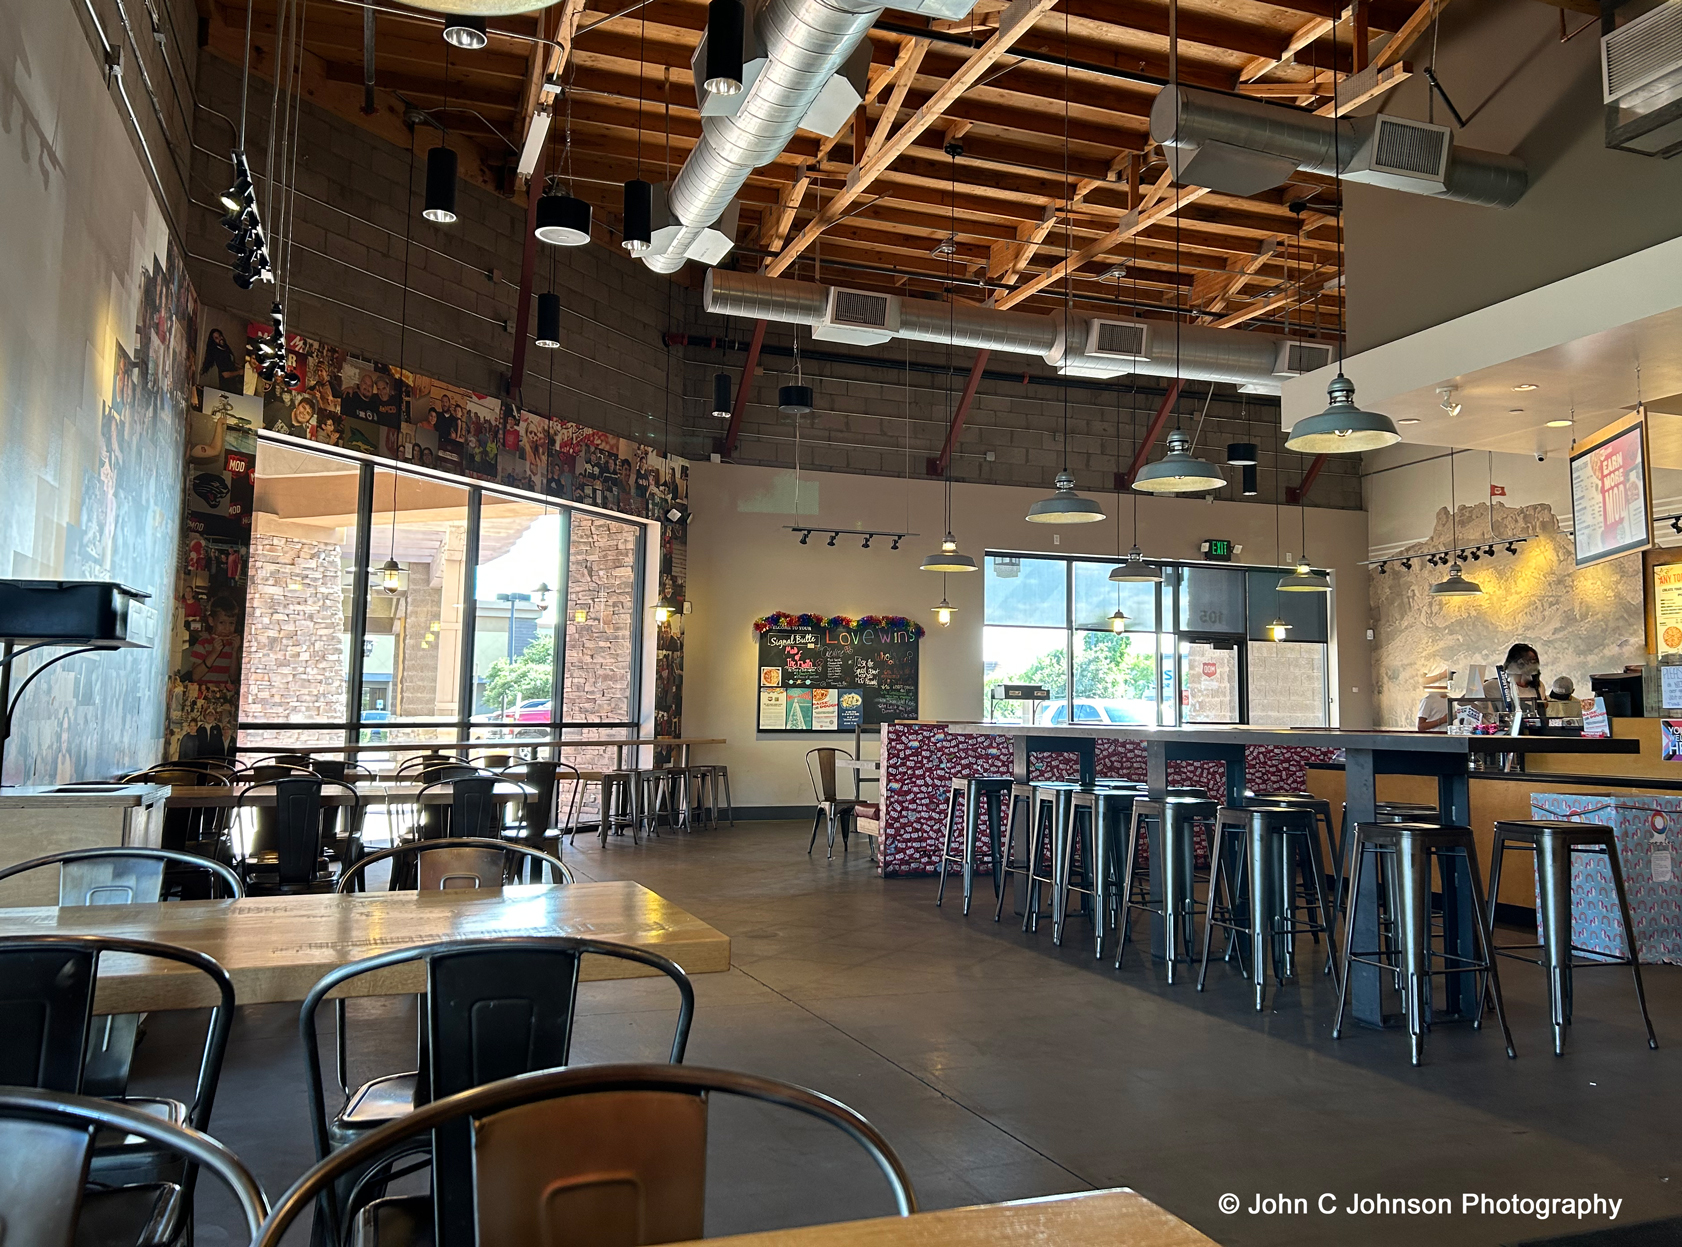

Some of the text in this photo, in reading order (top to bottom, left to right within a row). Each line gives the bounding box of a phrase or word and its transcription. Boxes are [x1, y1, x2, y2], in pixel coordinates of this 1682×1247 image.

[228, 459, 245, 472] MOD
[1602, 451, 1623, 475] EARN
[1603, 468, 1624, 491] MORE
[1604, 484, 1626, 525] MOD
[1212, 541, 1228, 555] EXIT
[1673, 573, 1682, 582] TO
[770, 635, 796, 648] Signal
[826, 629, 874, 645] Love
[1668, 726, 1682, 735] YO
